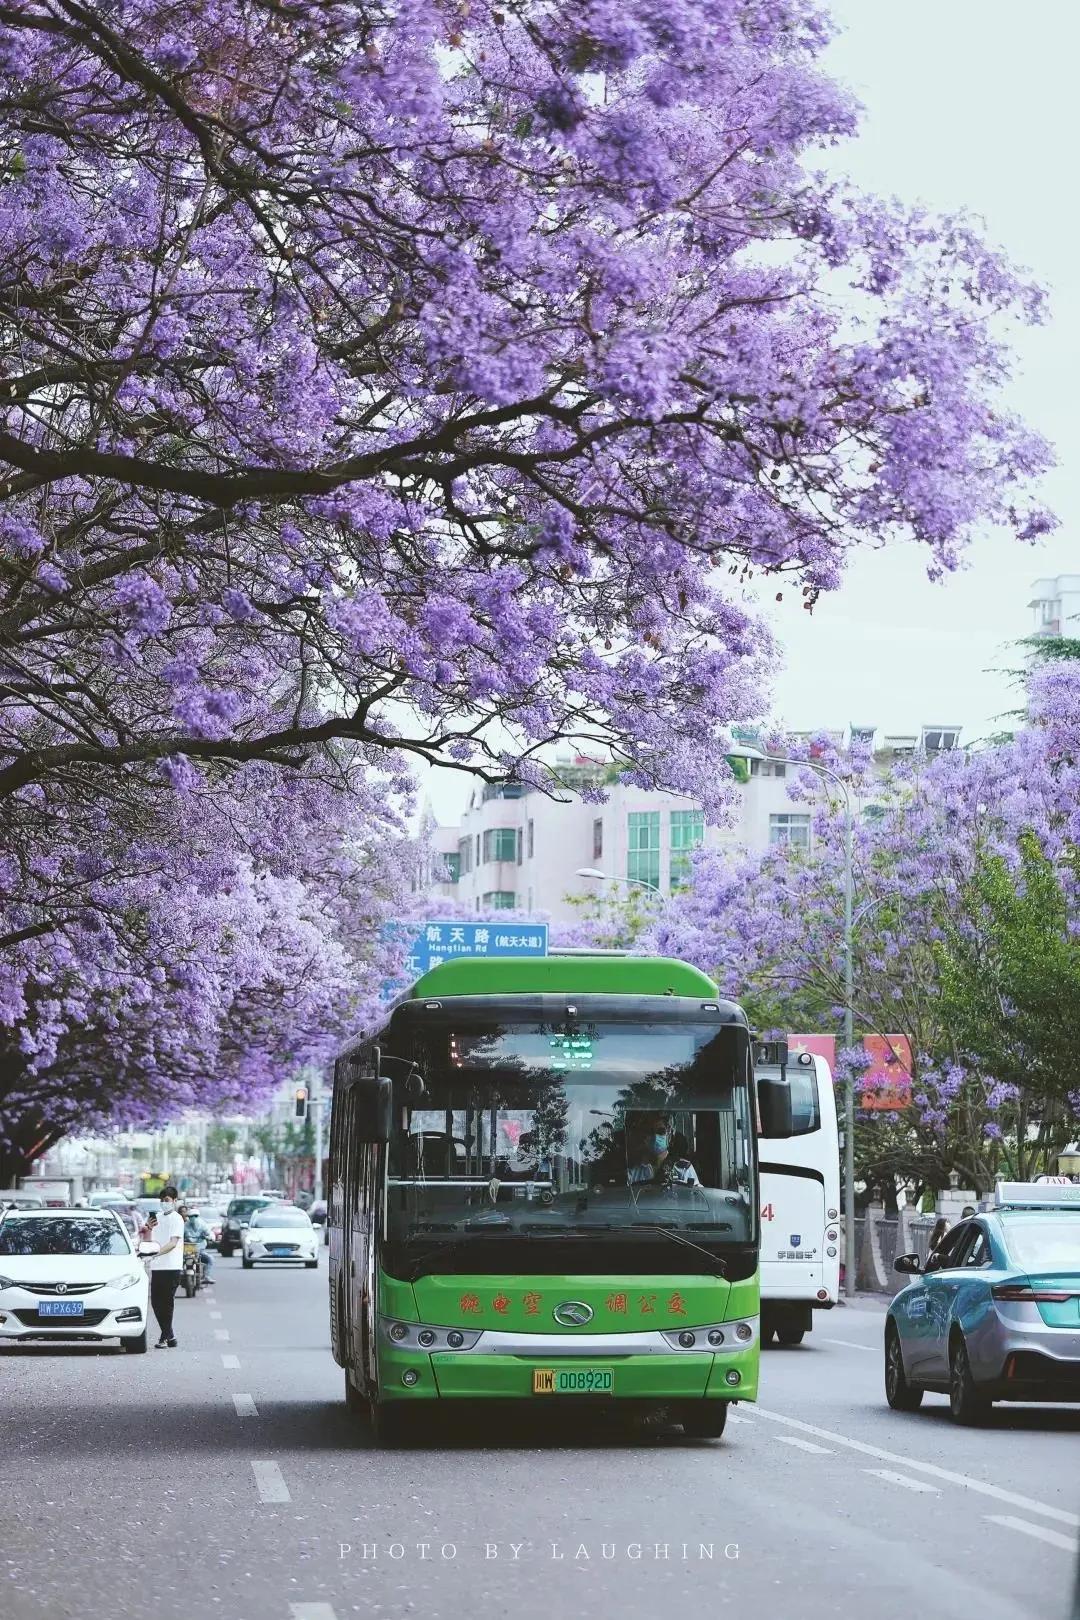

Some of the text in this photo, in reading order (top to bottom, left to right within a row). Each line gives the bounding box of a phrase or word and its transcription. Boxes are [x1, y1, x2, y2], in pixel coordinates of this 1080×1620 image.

[427, 926, 490, 944] 航天路
[429, 943, 488, 954] Hangtian Rd
